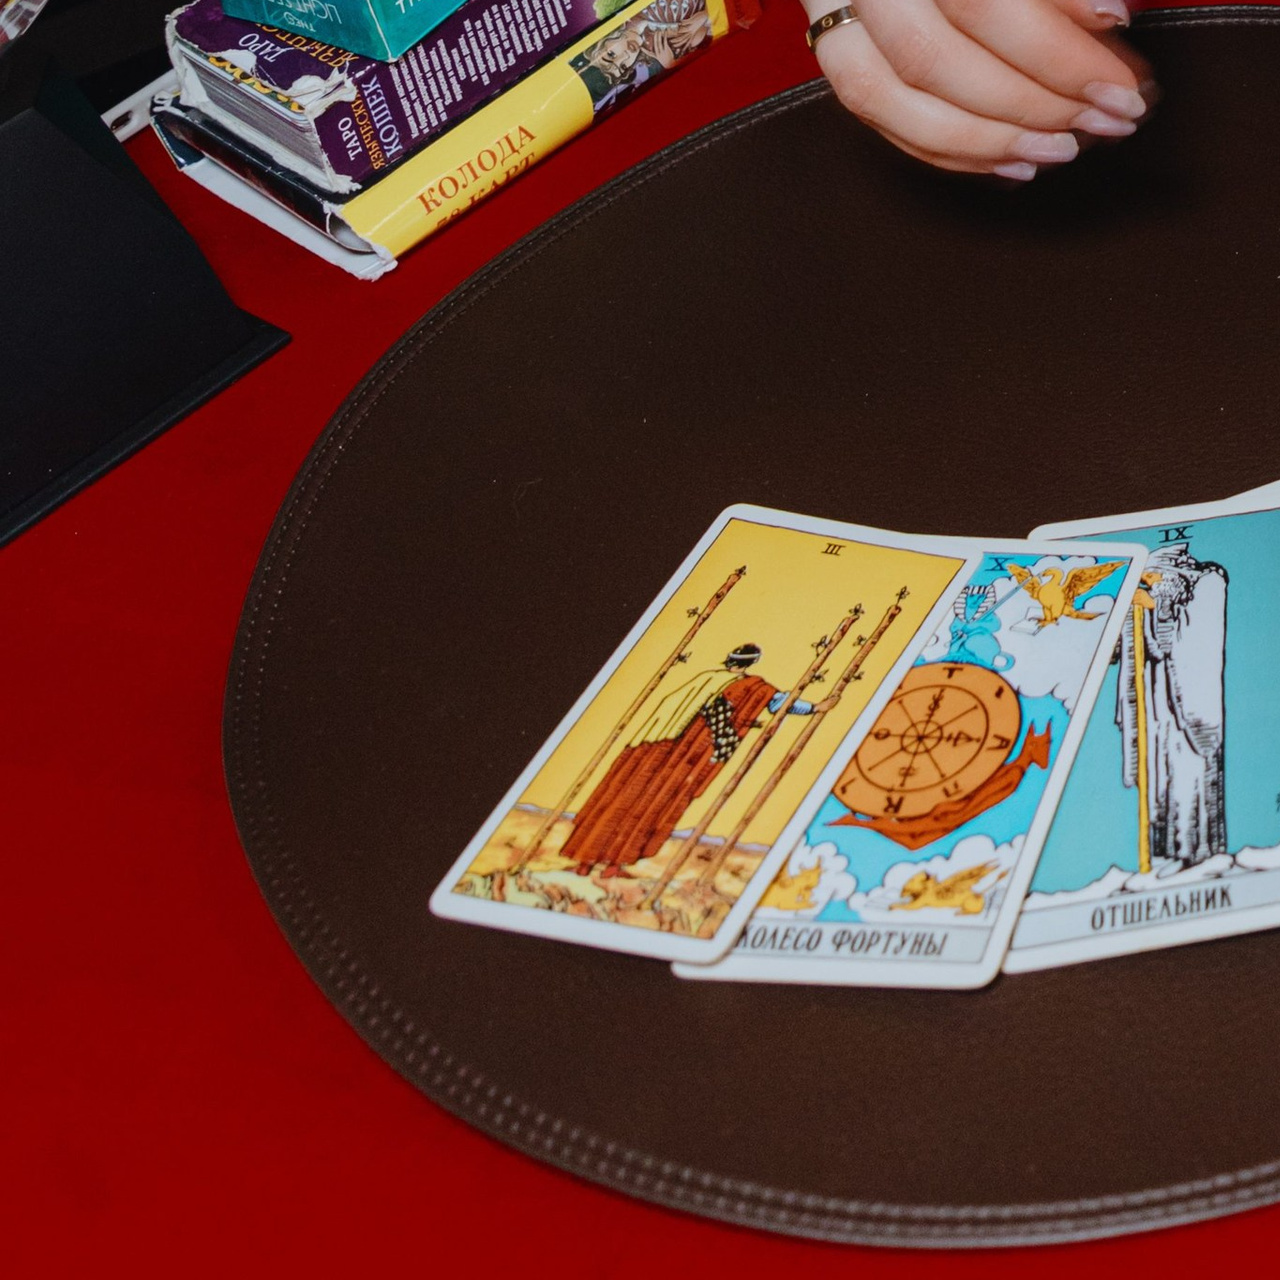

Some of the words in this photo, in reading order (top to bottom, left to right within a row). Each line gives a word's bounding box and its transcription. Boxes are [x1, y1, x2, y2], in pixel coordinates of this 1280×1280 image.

[238, 33, 286, 63] ТАРО
[361, 74, 403, 158] КОШЕК
[338, 117, 362, 161] ТАРО
[416, 125, 537, 215] КОЛОДА
[821, 543, 846, 556] III
[1158, 525, 1194, 543] IX
[985, 557, 1014, 571] X
[1091, 884, 1232, 930] ОТШЕЛЬНИК
[735, 925, 823, 951] КОЛЕСО
[832, 929, 949, 956] ФОРТУНЫ
